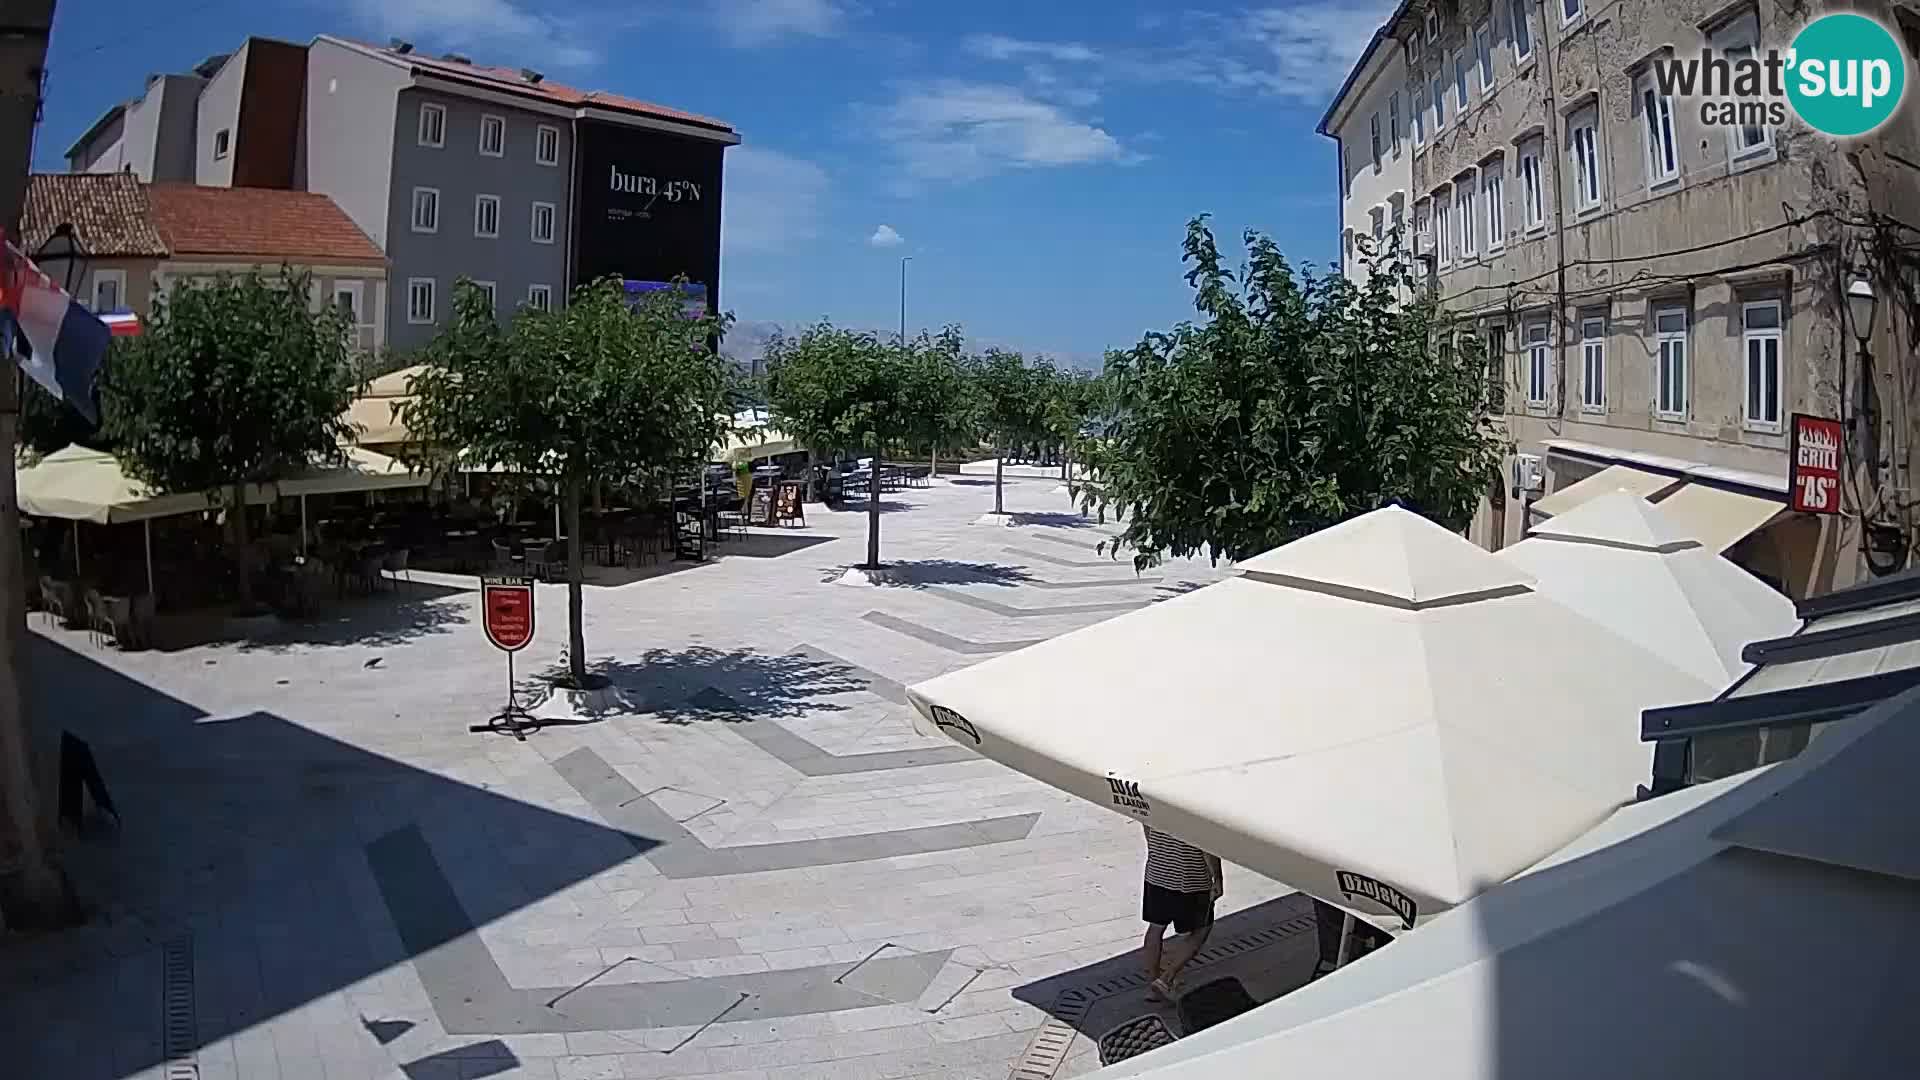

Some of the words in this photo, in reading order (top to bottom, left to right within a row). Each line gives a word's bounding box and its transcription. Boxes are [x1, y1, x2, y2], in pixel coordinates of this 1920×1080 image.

[610, 164, 657, 195] bura
[1798, 446, 1838, 471] GRILL
[484, 577, 503, 585] WINE
[505, 577, 522, 585] BAR
[1342, 873, 1411, 920] Ožujsko
